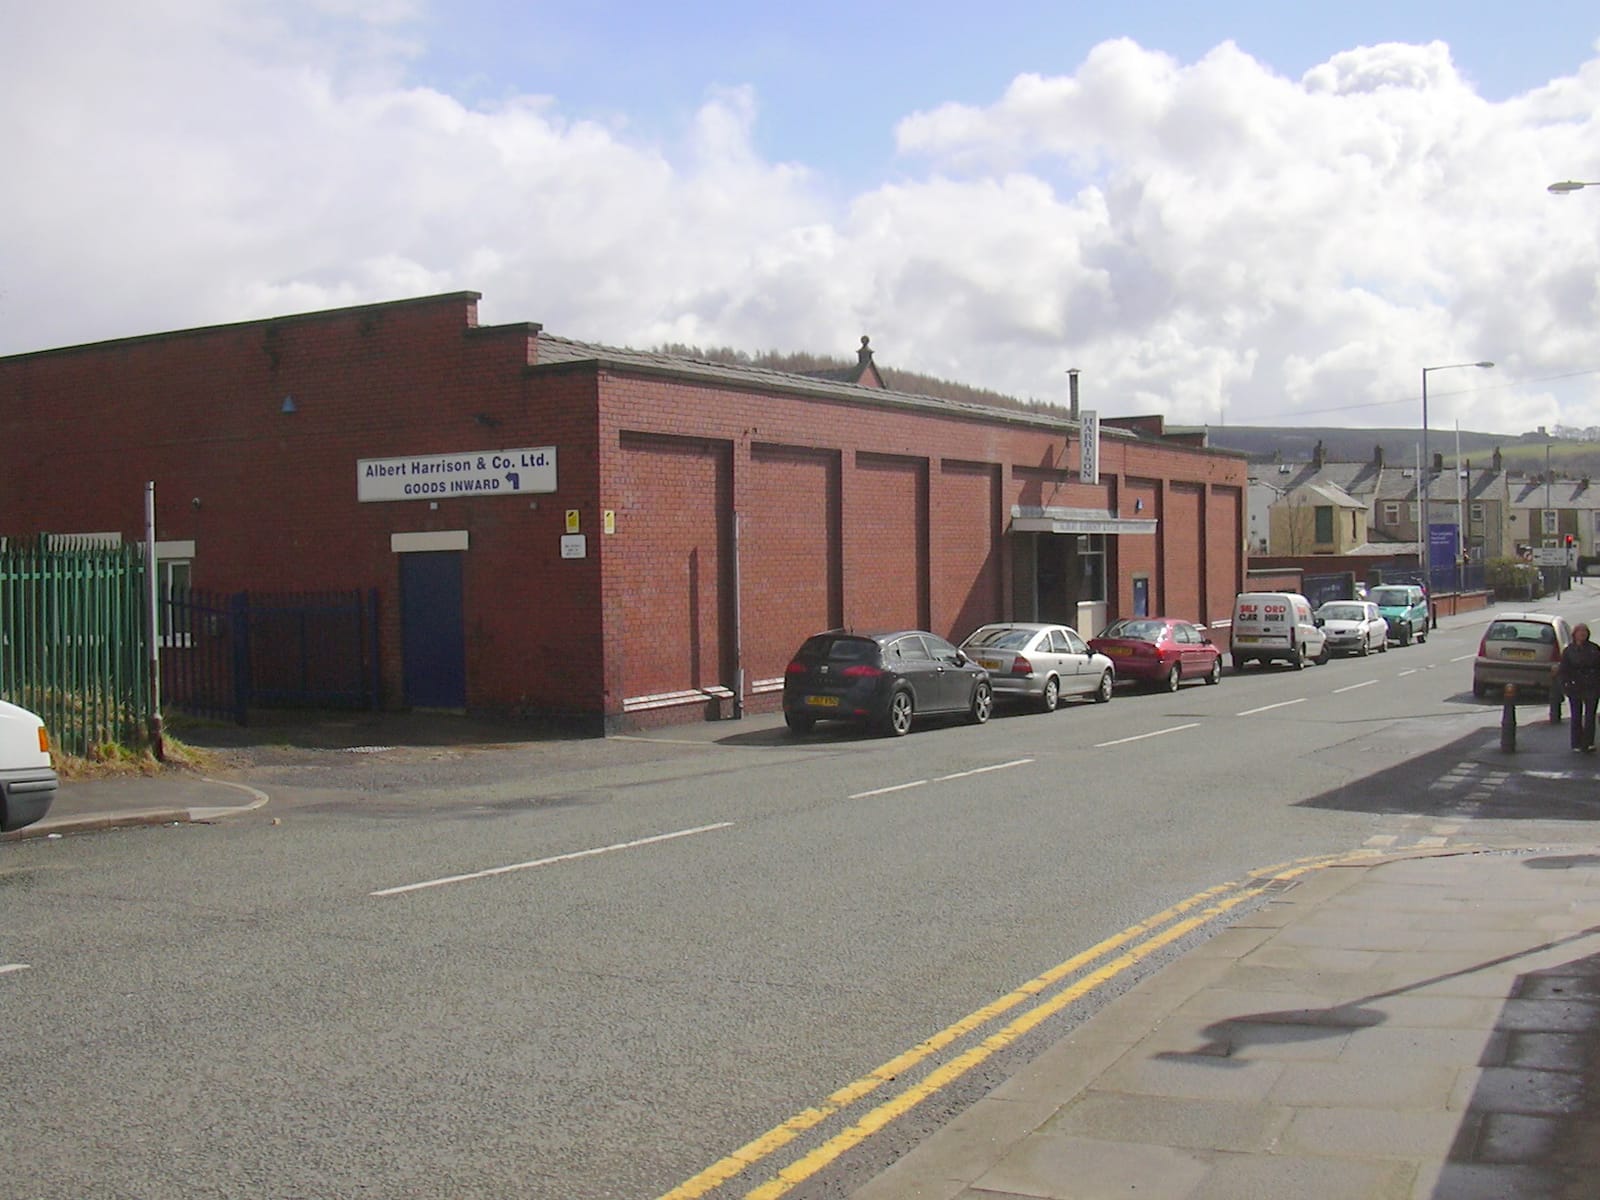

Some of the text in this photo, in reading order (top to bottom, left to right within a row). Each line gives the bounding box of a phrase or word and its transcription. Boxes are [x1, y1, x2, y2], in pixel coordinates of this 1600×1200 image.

[366, 453, 549, 477] Albert Harrison & Co. Ltd.
[404, 478, 500, 494] GOODS INWARD
[1239, 613, 1258, 622] CAR
